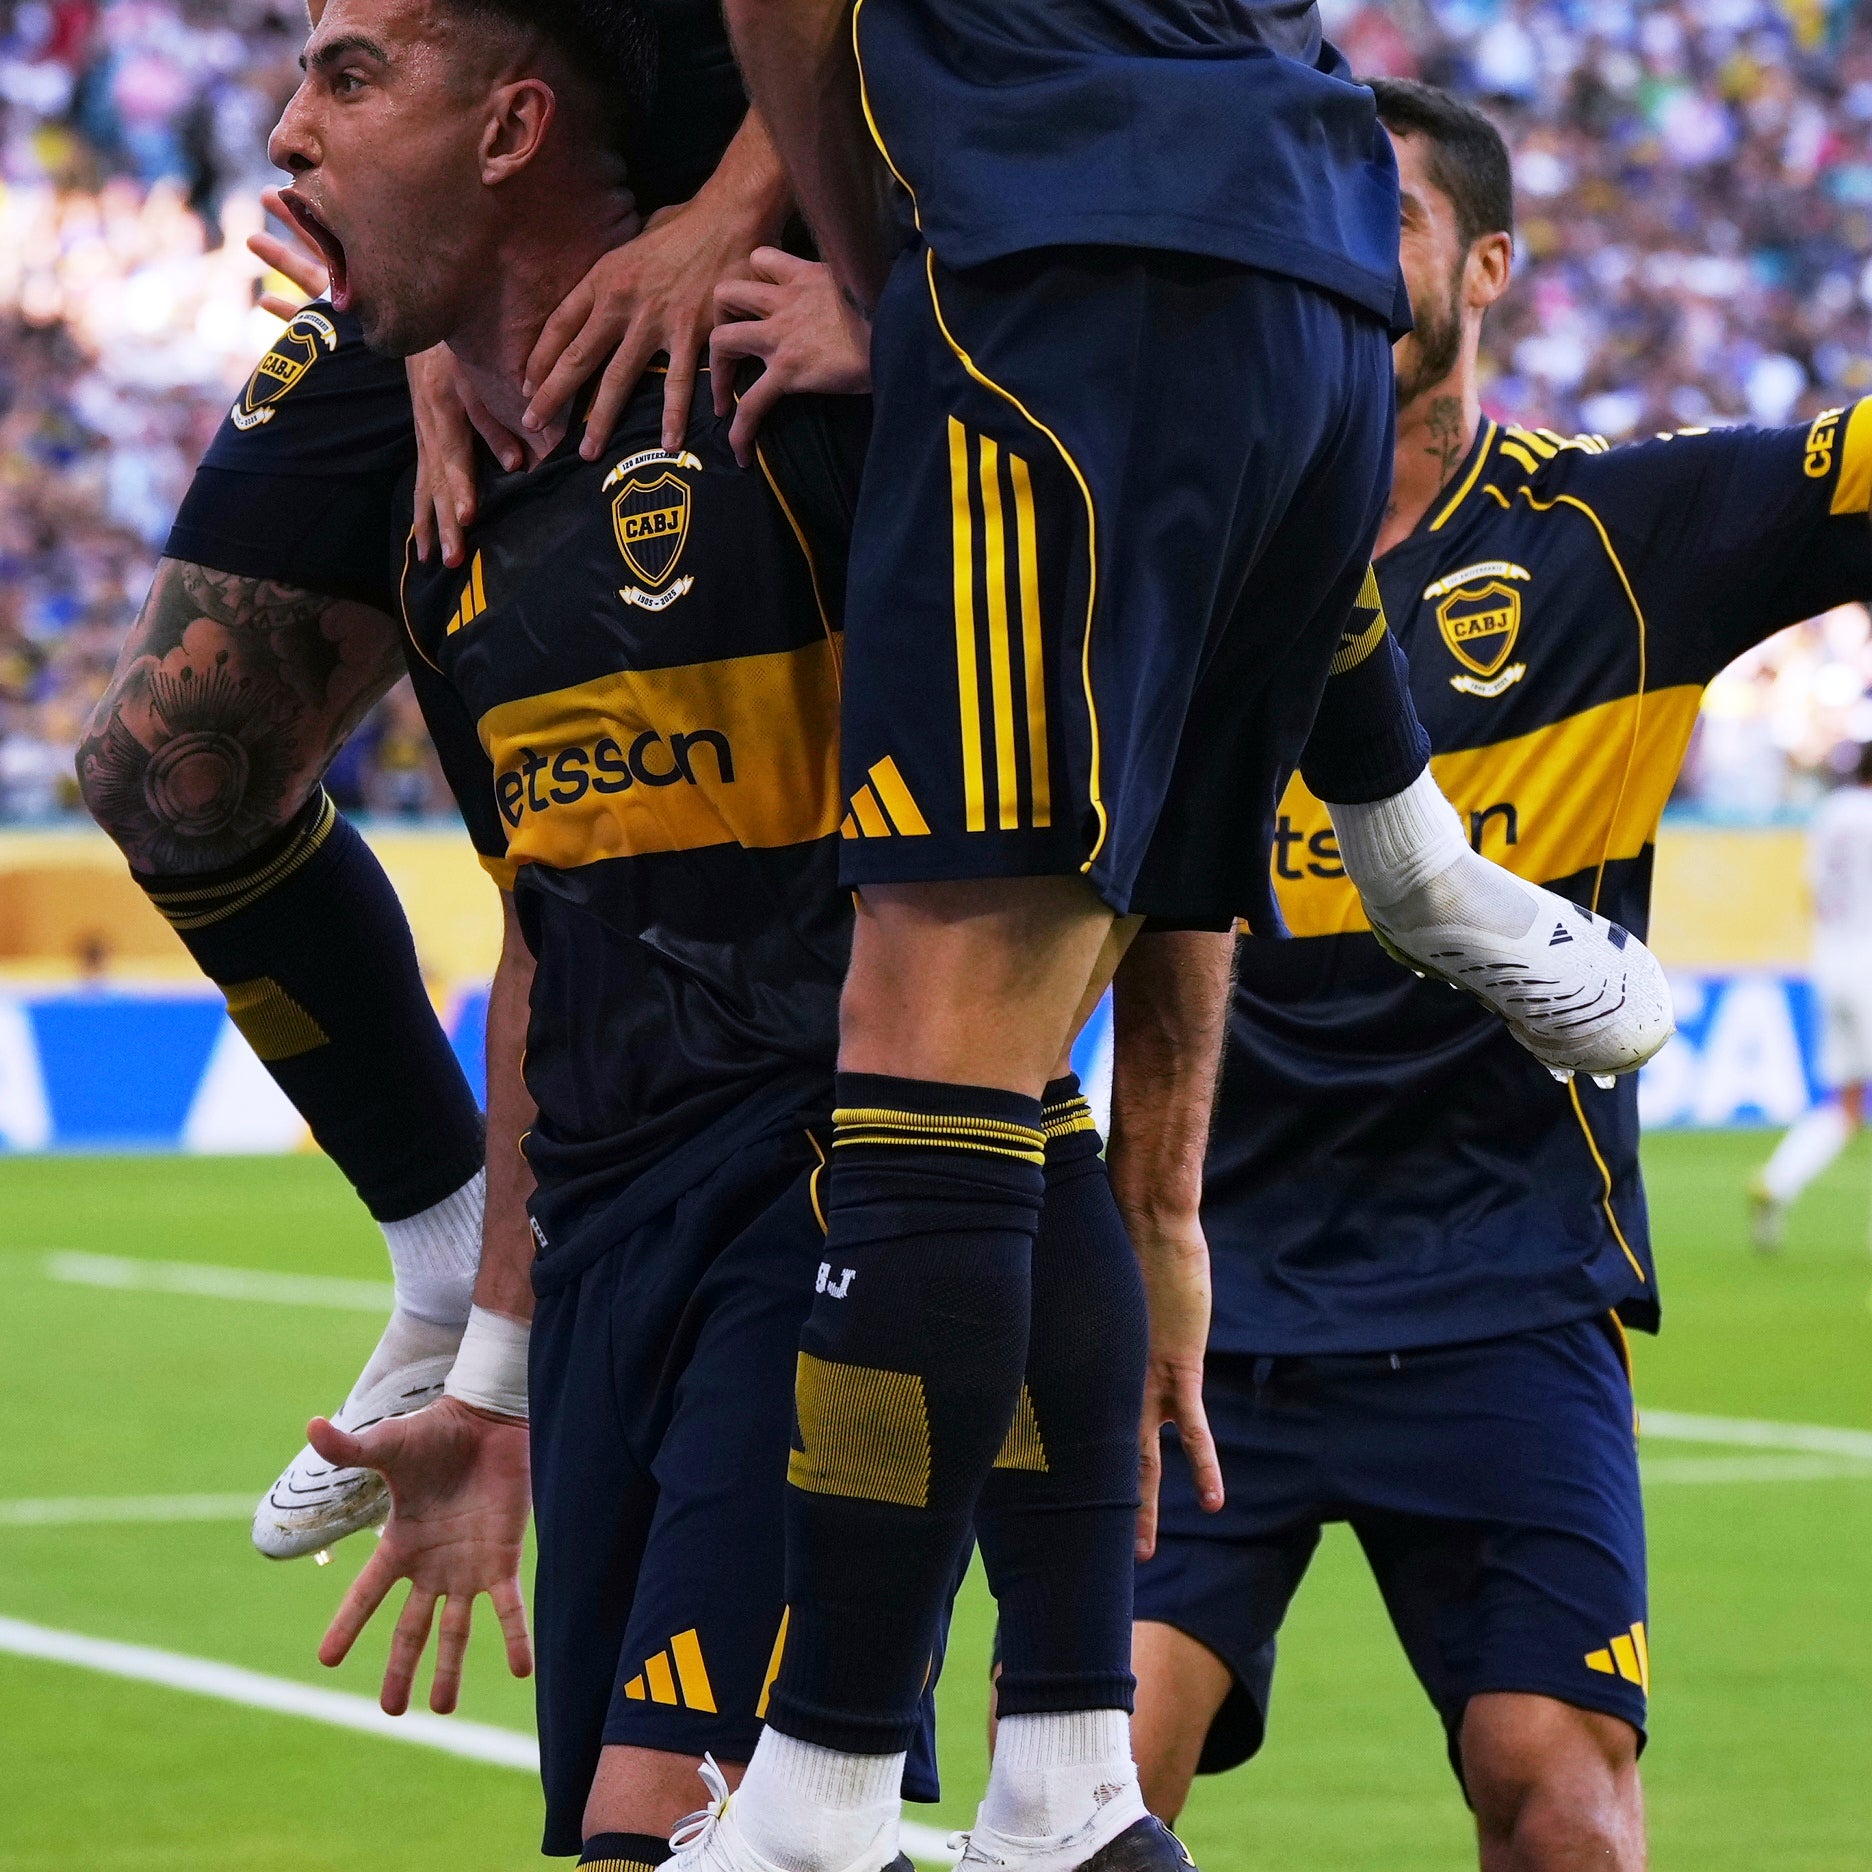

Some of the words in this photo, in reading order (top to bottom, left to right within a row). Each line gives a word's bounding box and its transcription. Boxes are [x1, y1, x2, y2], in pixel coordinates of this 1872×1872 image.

[262, 355, 296, 379] CABJ
[625, 510, 679, 539] CABJ
[637, 594, 653, 607] 1905
[660, 589, 677, 606] 2025
[1454, 612, 1508, 637] CABJ
